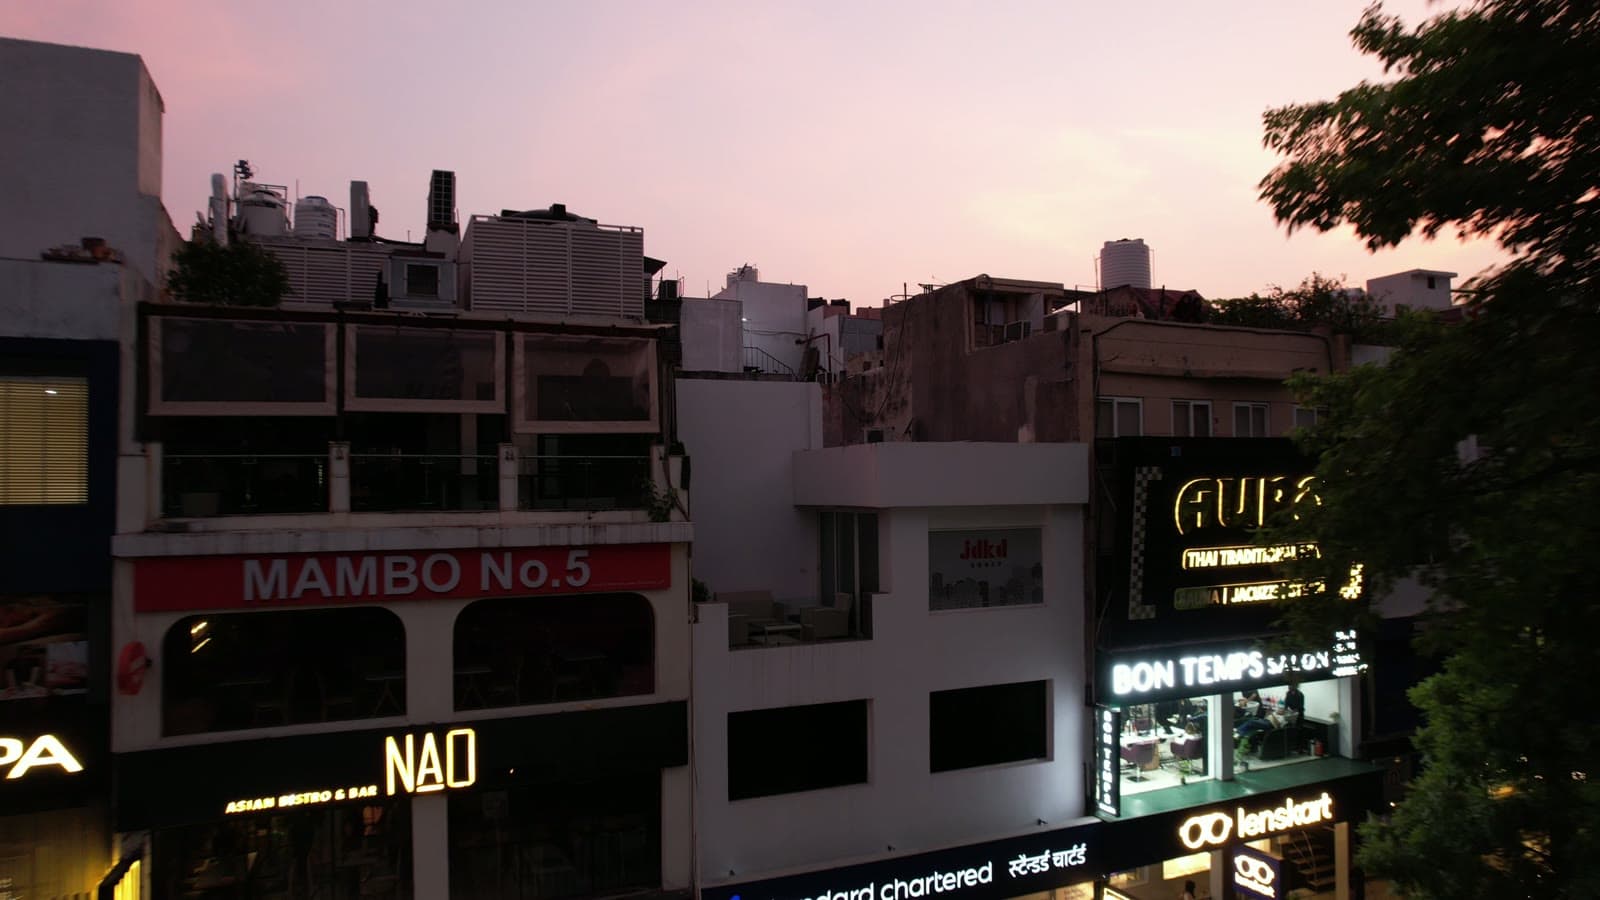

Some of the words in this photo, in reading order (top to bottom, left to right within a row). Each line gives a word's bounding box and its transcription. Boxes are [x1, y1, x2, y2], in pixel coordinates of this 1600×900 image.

[242, 552, 462, 601] MAMBO
[480, 550, 592, 591] No.5
[1187, 549, 1219, 568] THAI
[1112, 660, 1175, 695] BON
[1180, 651, 1265, 686] TEMPS
[1267, 650, 1330, 675] SALON
[385, 728, 476, 796] NAO
[225, 797, 276, 814] ASIAN
[278, 790, 331, 808] BISTRO
[335, 788, 346, 801] &
[348, 785, 378, 799] BAR
[1237, 792, 1334, 838] lenskart
[880, 860, 993, 900] chartered
